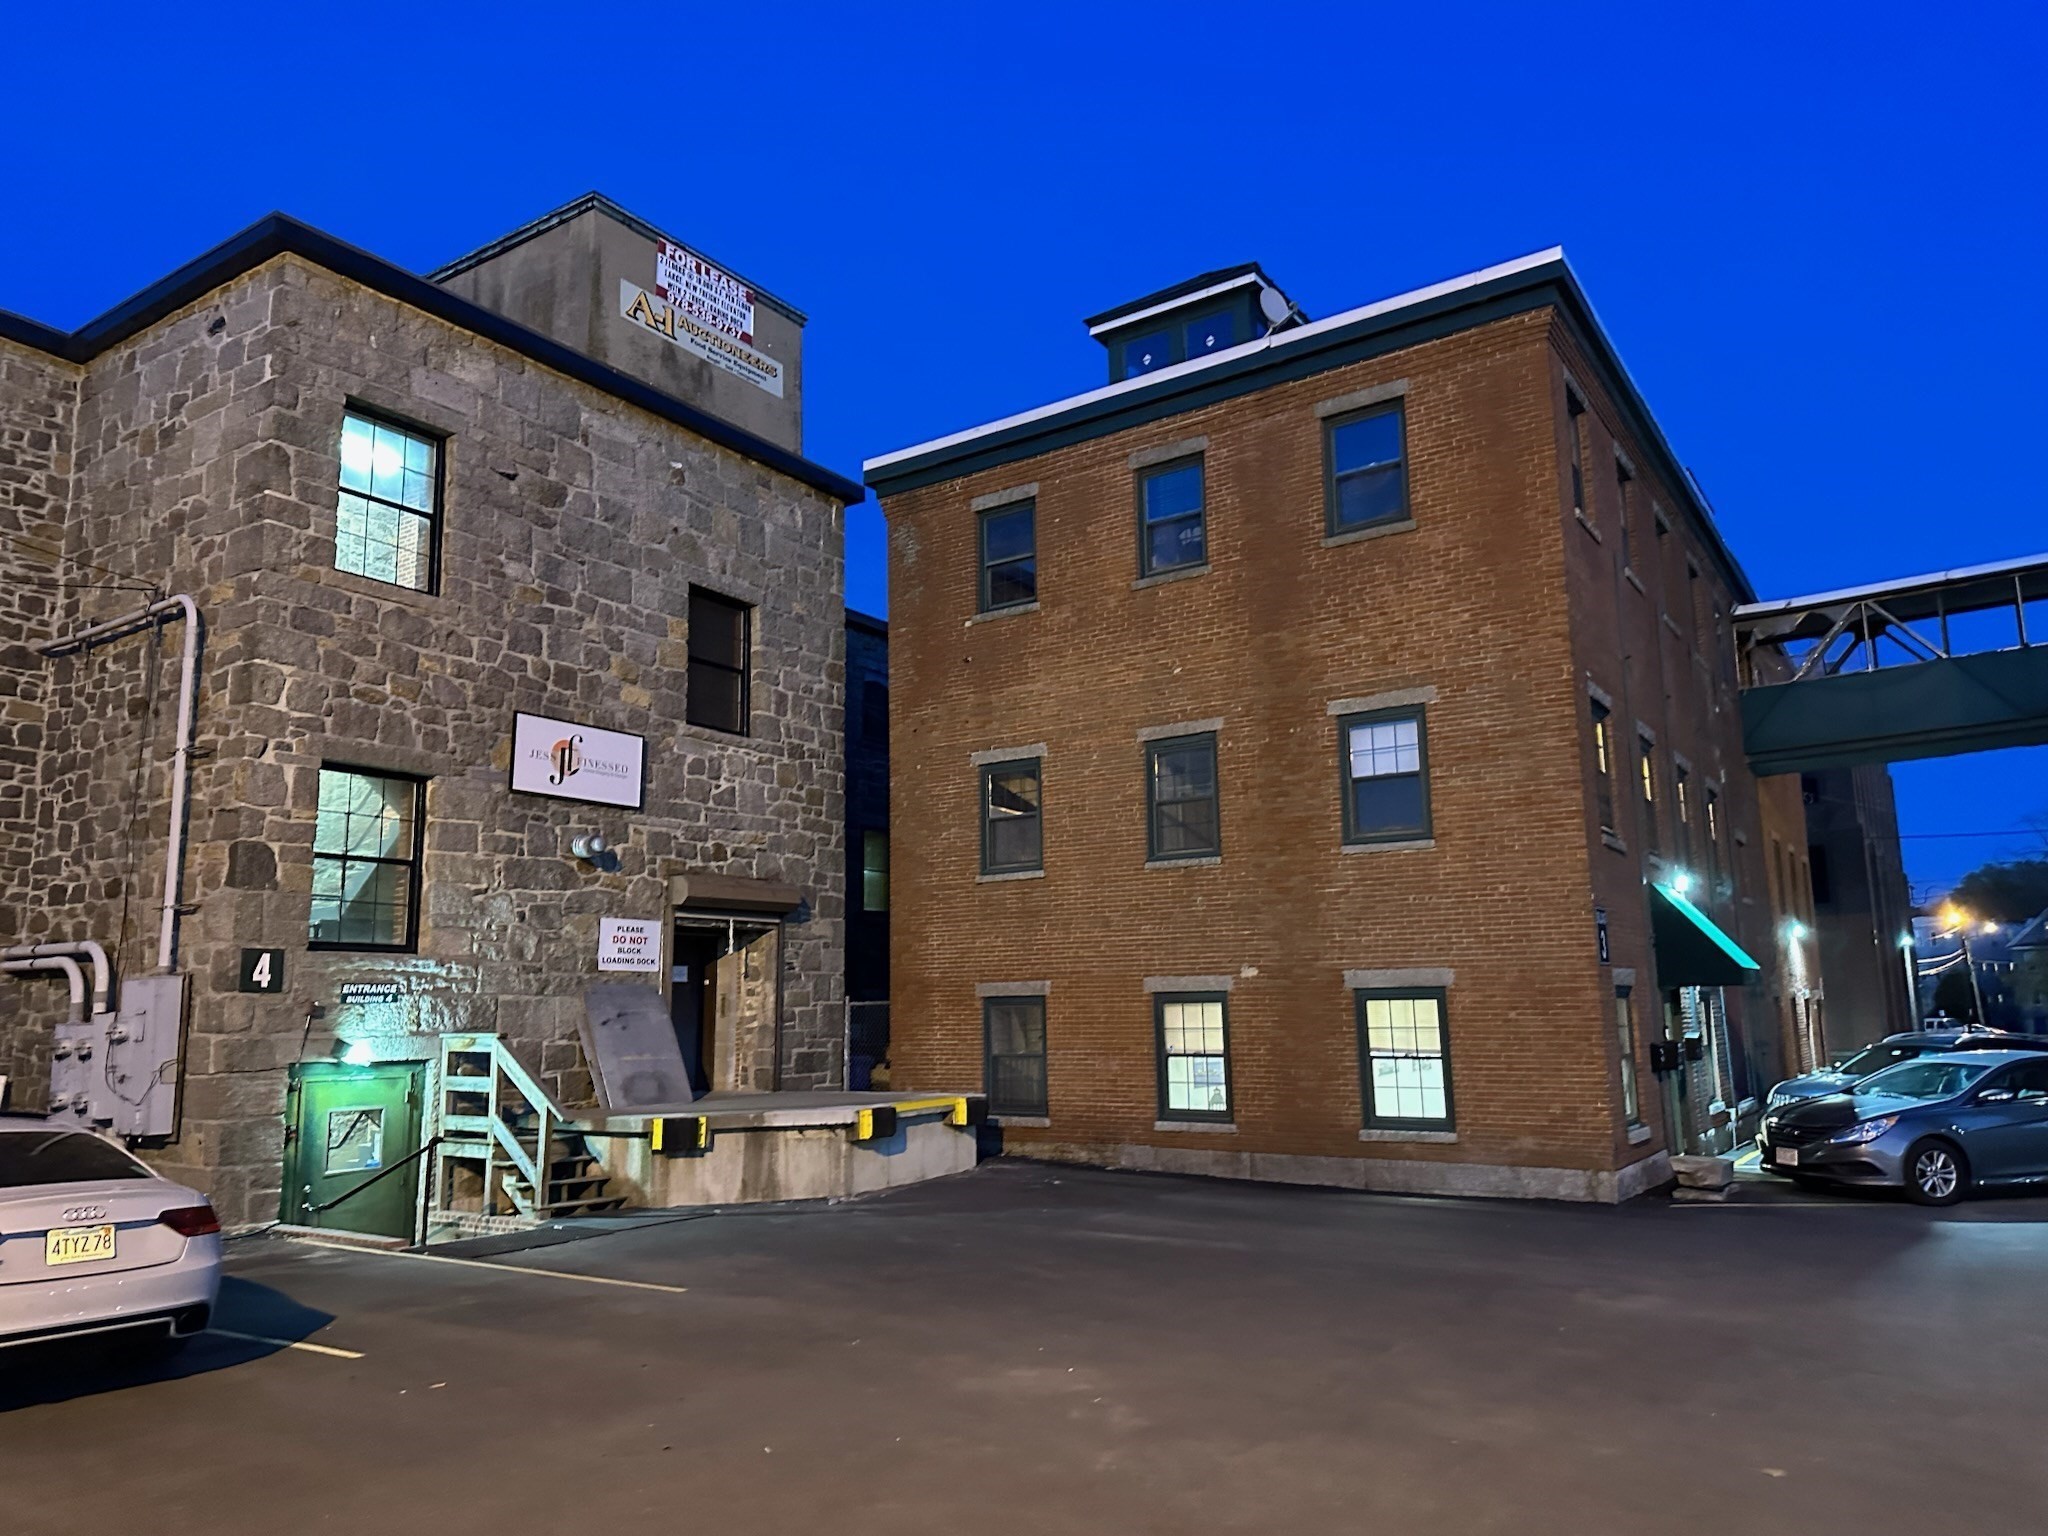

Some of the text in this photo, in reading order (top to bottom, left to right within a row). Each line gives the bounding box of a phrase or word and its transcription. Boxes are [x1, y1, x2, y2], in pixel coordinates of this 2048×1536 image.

[665, 244, 747, 301] FOR LEASE
[664, 269, 745, 319] LARGE NEW FREIGHT ELEVATOR
[667, 282, 681, 293] WITH
[688, 293, 704, 306] TRUCK
[706, 303, 728, 320] LOADING
[677, 314, 777, 378] AUCTIONEERS
[612, 936, 648, 945] DO NOT
[252, 952, 271, 988] 4
[342, 984, 397, 993] ENTRANCE
